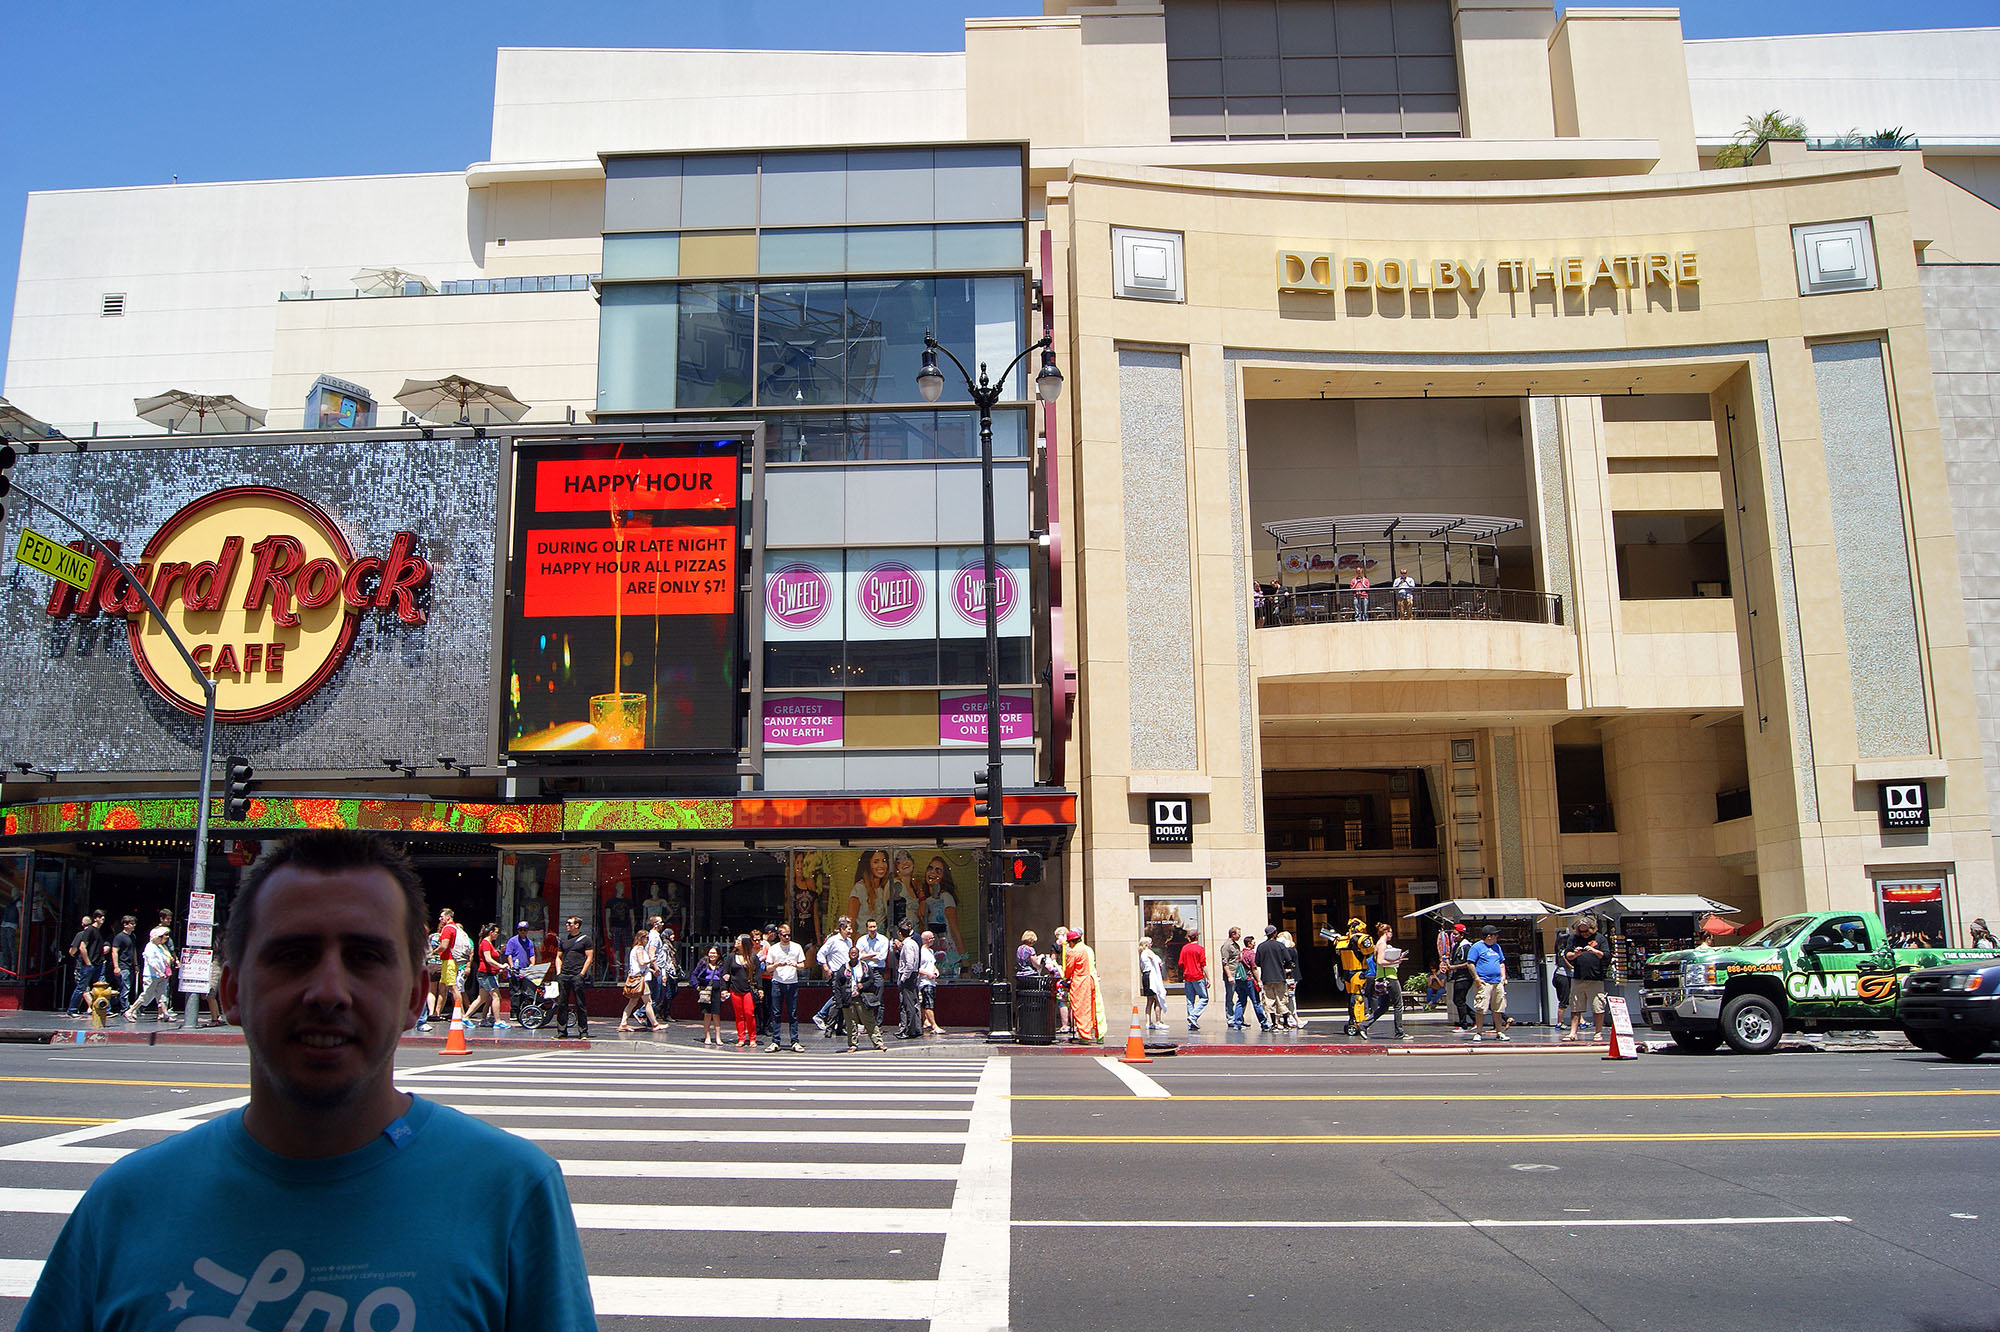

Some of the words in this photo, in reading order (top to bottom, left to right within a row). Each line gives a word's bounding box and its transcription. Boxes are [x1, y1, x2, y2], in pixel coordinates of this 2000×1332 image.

[1344, 257, 1486, 292] DOLBY
[1497, 249, 1702, 290] THEATRE
[564, 474, 640, 493] HAPPY
[646, 472, 713, 491] HOUR
[537, 541, 598, 555] DURING
[602, 540, 636, 553] OUR
[640, 540, 674, 552] LATE
[678, 538, 728, 551] NIGHT
[22, 536, 52, 565] PED
[55, 551, 89, 582] XING
[541, 562, 591, 575] HAPPY
[595, 560, 640, 574] HOUR
[644, 560, 670, 573] ALL
[675, 559, 727, 573] PIZZAS
[46, 535, 244, 618] Hard
[245, 531, 433, 627] Rock
[626, 581, 656, 594] ARE
[660, 580, 701, 594] ONLY
[704, 580, 726, 593] $7!
[964, 574, 1006, 612] SWT!
[191, 642, 286, 673] CAFE
[773, 704, 823, 714] GREATEST
[961, 702, 1011, 712] GREAST
[763, 716, 798, 726] CANDY
[800, 716, 833, 726] STORE
[951, 714, 986, 723] CANDY
[771, 728, 789, 737] ON
[792, 728, 824, 737] EARTH
[960, 726, 980, 735] ON
[981, 725, 1014, 735] ETH
[1888, 810, 1923, 819] DOLBY
[1155, 826, 1187, 835] DOLBY
[1727, 963, 1783, 972] 888-602-GAME
